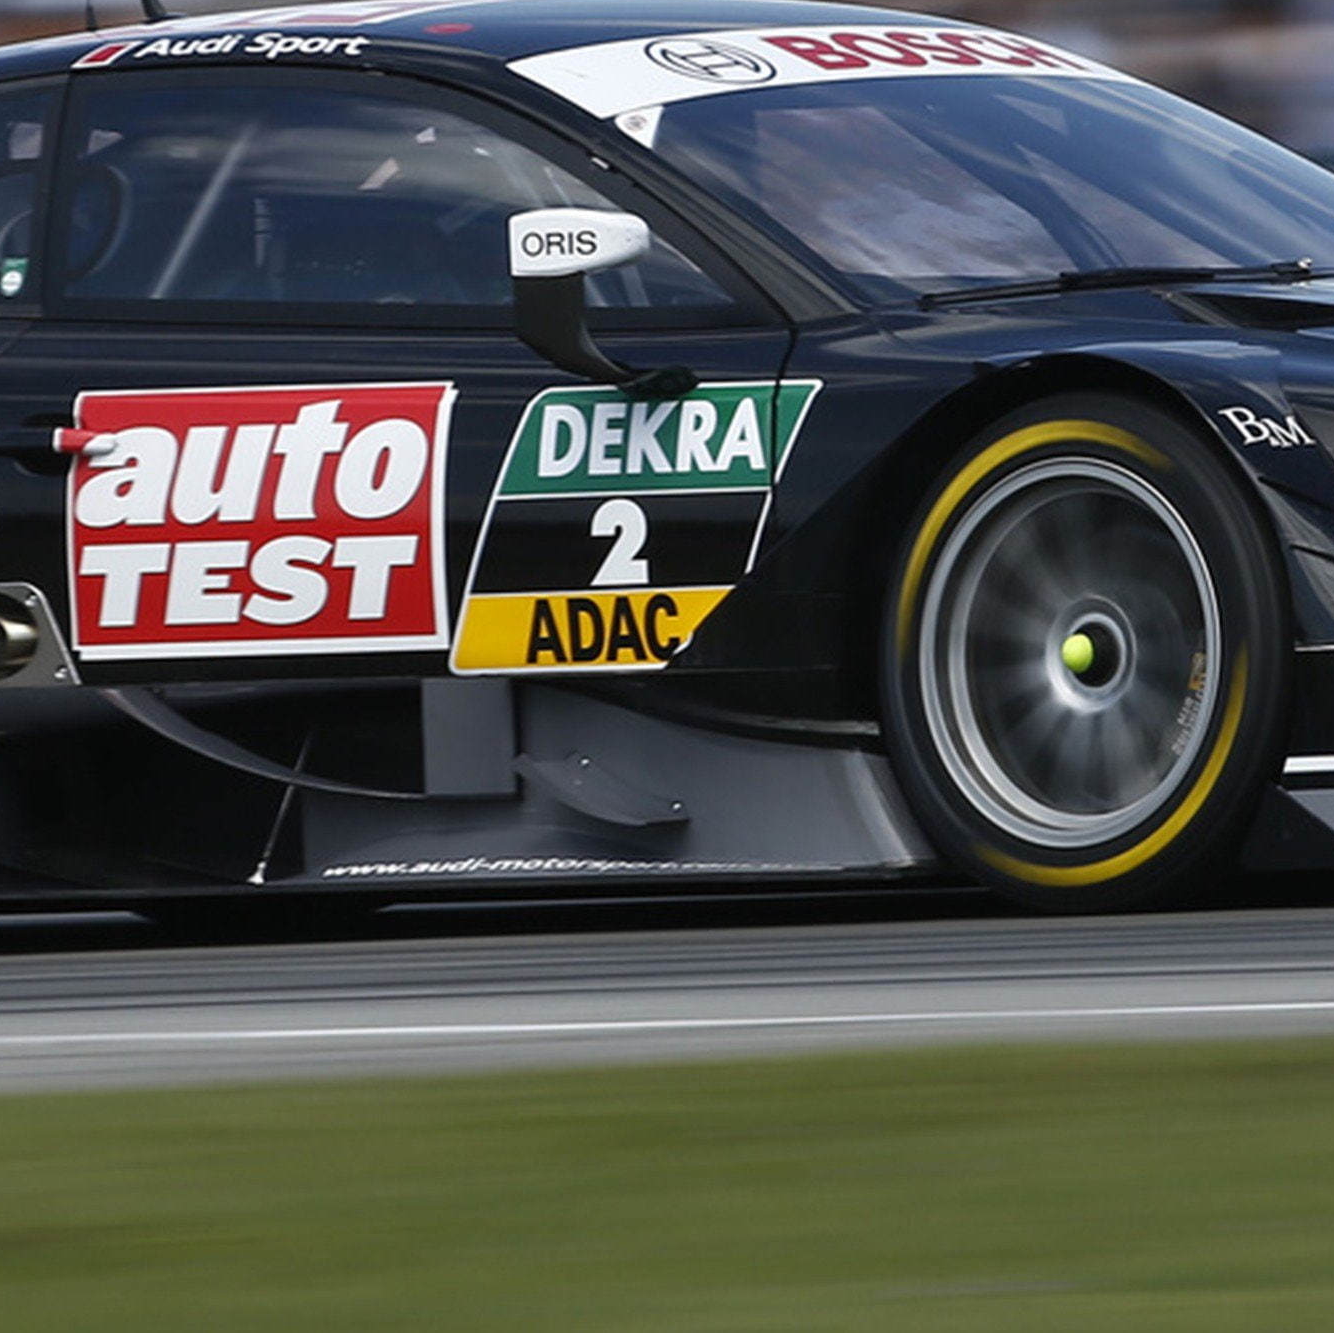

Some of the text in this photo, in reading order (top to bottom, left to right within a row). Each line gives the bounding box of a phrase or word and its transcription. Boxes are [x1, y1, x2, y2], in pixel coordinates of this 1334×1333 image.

[134, 32, 369, 59] Audi Sport
[763, 32, 1087, 71] BOSCH
[521, 230, 598, 258] ORIS
[75, 399, 429, 528] auto
[537, 397, 767, 478] DEKRA
[589, 498, 650, 587] 2
[79, 534, 419, 628] TEST
[525, 593, 682, 665] ADAC
